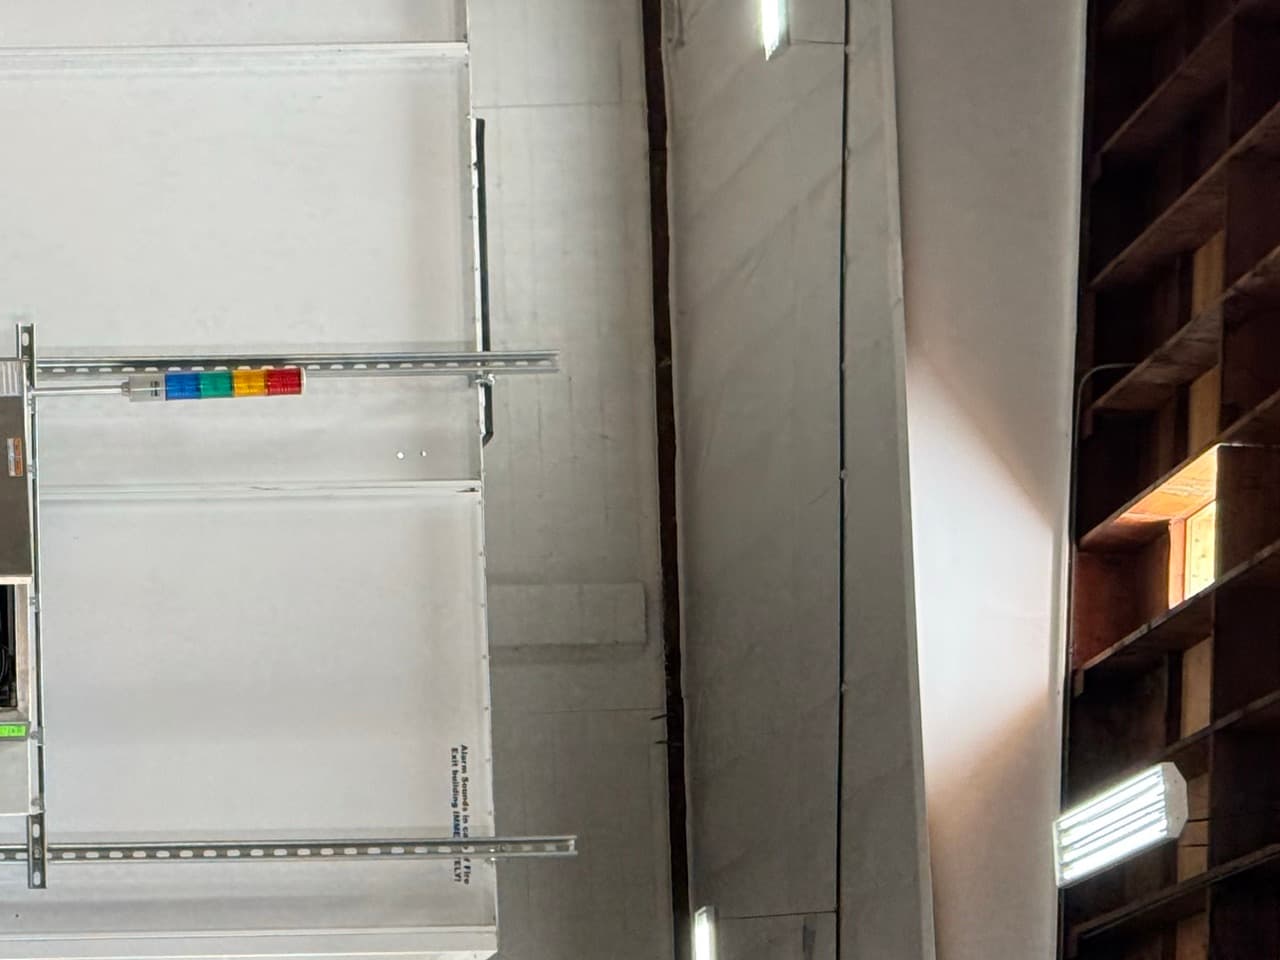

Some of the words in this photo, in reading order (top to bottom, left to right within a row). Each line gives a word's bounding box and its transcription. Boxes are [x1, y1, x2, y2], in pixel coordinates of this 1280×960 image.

[451, 747, 459, 767] Exit
[461, 744, 469, 774] Alarm
[451, 769, 460, 809] building
[461, 776, 469, 812] Sounds
[462, 814, 470, 824] in
[463, 865, 471, 886] Fire
